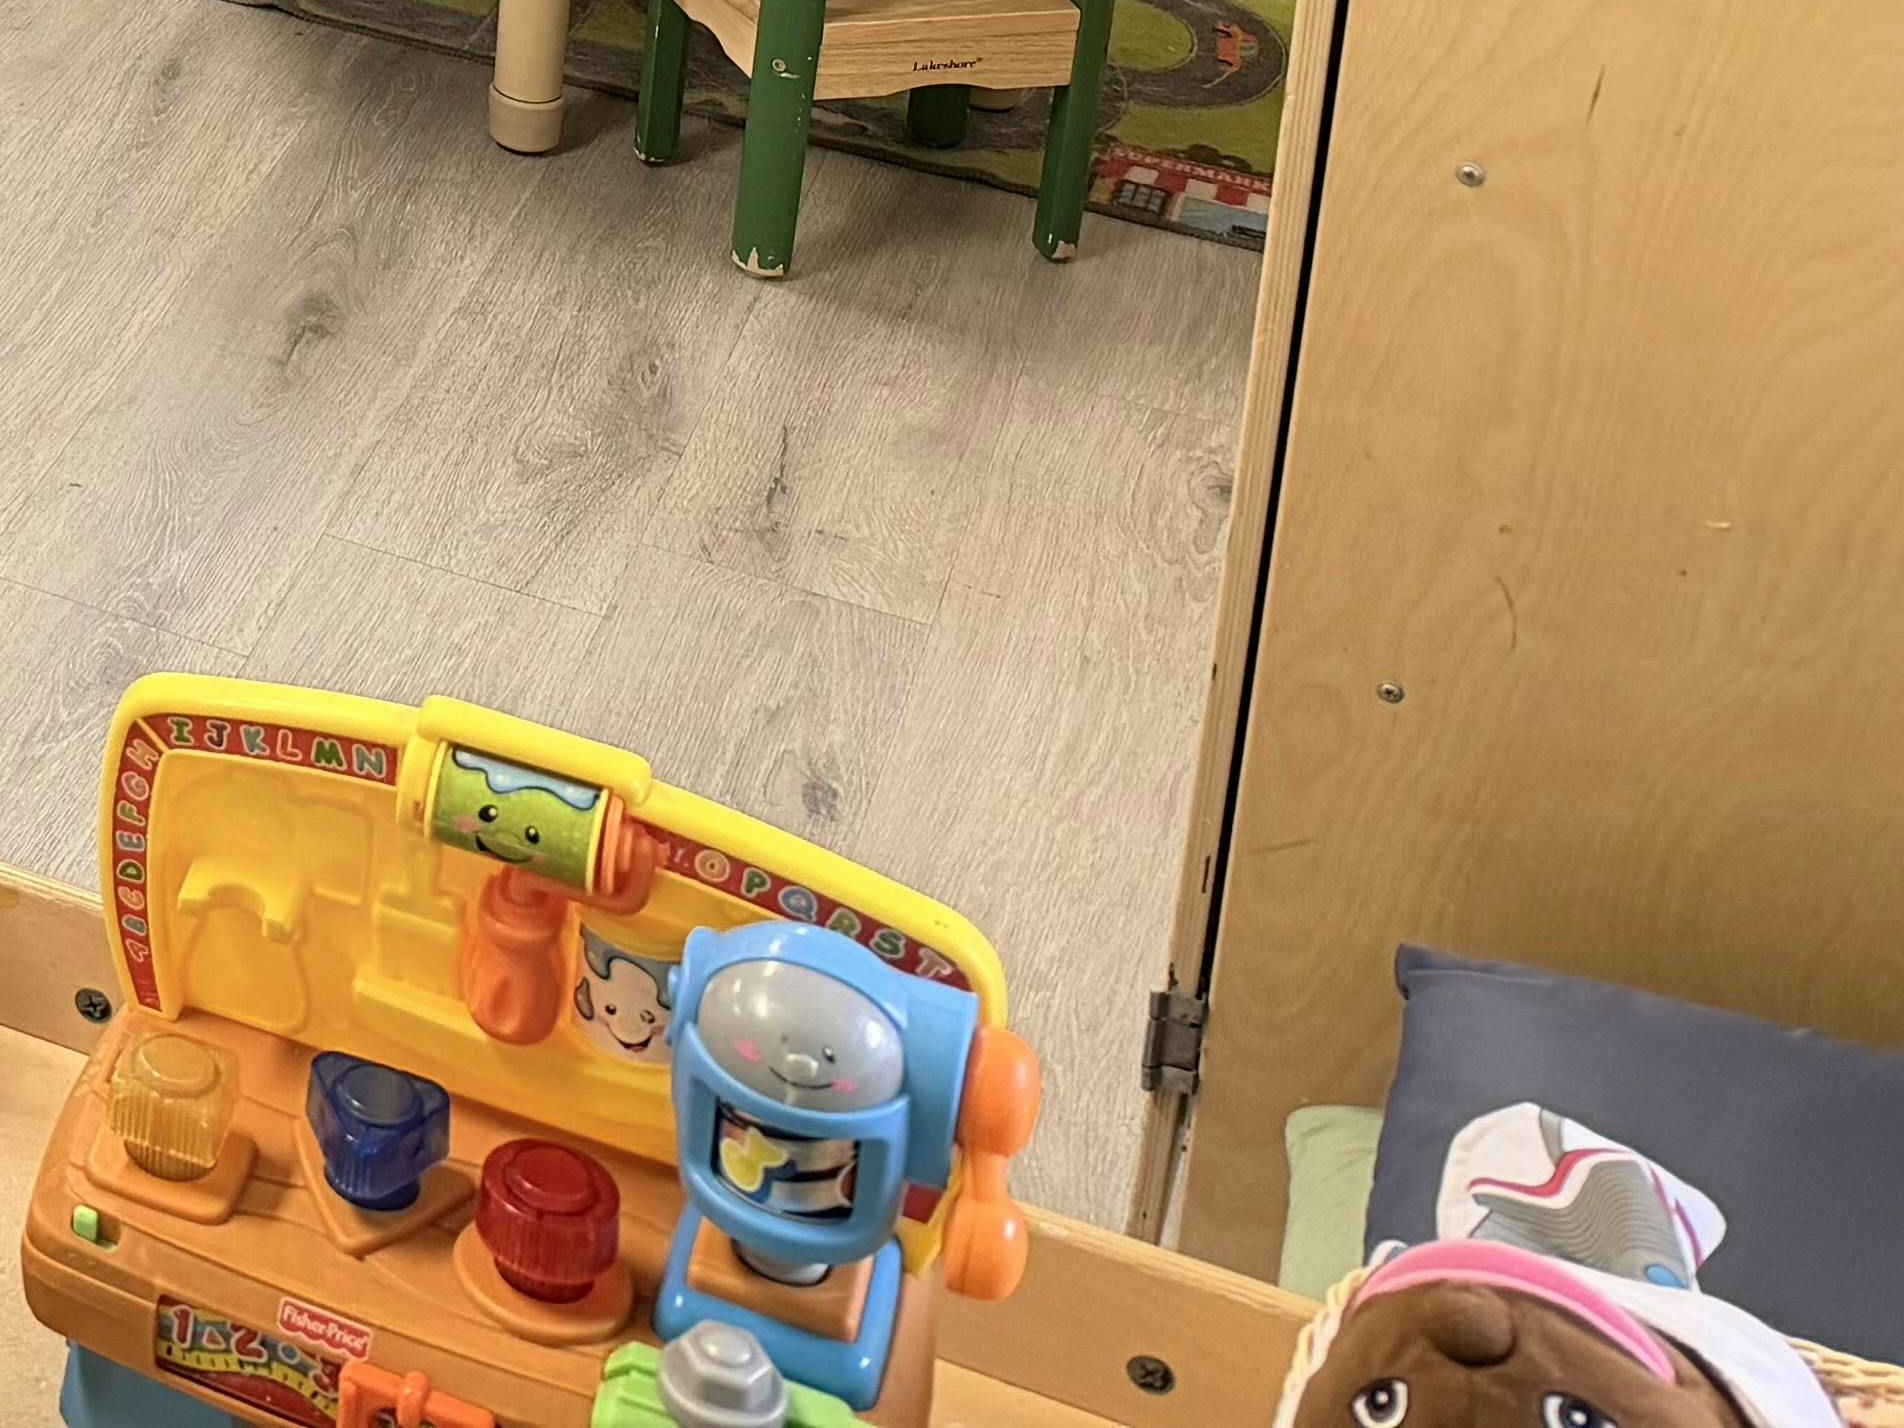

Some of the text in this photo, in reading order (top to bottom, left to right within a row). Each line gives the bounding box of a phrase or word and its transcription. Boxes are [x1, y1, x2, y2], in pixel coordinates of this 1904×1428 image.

[912, 57, 983, 73] Lakeshore
[172, 1305, 193, 1348] 1
[230, 1320, 268, 1363] 2
[282, 1305, 368, 1352] Fisher-Price
